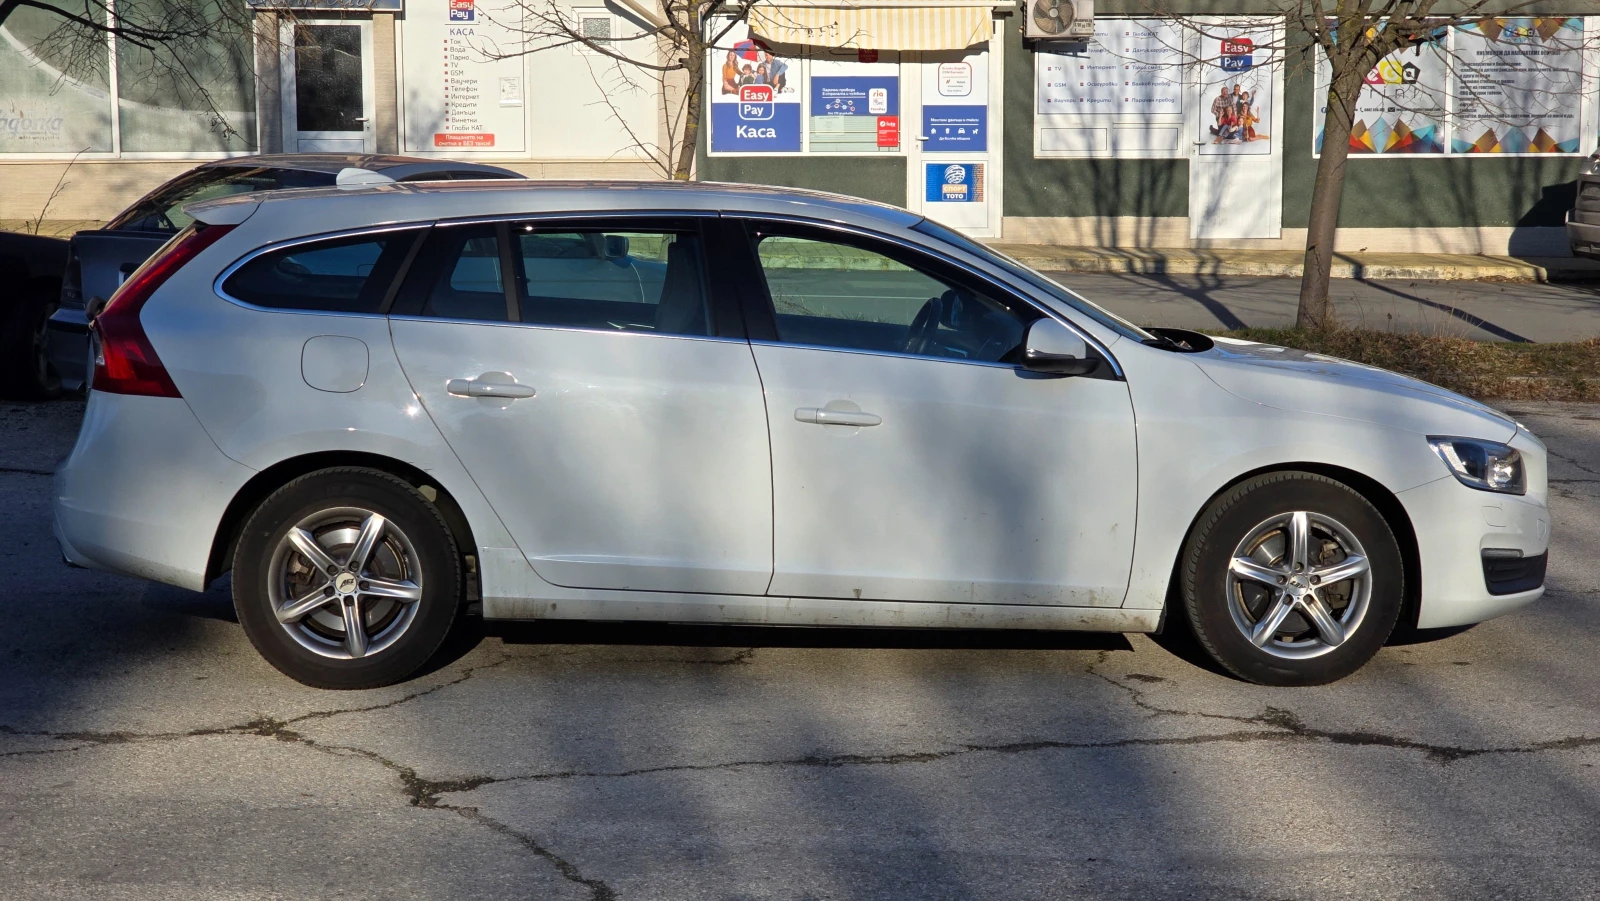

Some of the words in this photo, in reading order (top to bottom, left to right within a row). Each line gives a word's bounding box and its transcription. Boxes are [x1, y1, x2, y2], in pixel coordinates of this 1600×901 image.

[450, 0, 474, 10] Easy
[450, 10, 469, 19] Pay
[449, 28, 475, 36] КАСА
[1224, 57, 1244, 69] Pay
[743, 90, 770, 102] Easy
[743, 104, 764, 117] Pay
[736, 125, 777, 138] Каса
